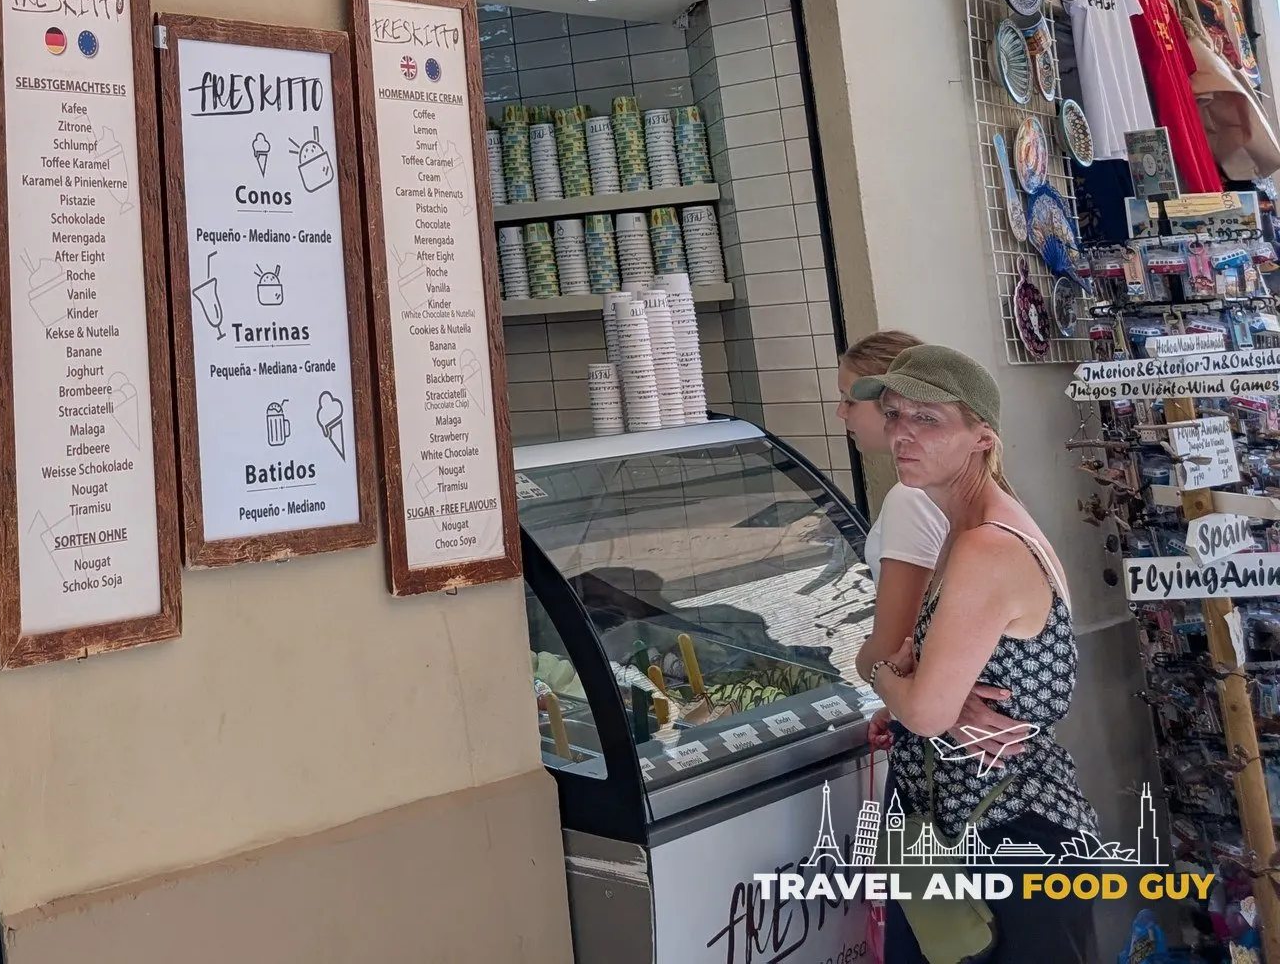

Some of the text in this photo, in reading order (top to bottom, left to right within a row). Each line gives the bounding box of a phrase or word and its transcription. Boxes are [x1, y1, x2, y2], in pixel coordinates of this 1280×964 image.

[372, 18, 459, 50] FRESKITTO
[15, 77, 126, 95] SELBSTGEMACHTES EIS
[188, 71, 323, 116] FRESKITTO
[379, 88, 463, 104] HOMEMADE ICE CREAM
[61, 103, 87, 114] Kafee
[413, 109, 435, 119] Coffee
[58, 121, 92, 133] Zitrone
[413, 126, 437, 135] Lemon
[53, 139, 98, 151] Schlumpf
[416, 141, 438, 150] Smurf
[41, 157, 110, 169] Toffee Karamel
[401, 155, 453, 167] Toffee Caramel
[22, 175, 127, 189] Karamel & Pinienkerne
[418, 172, 441, 181] Cream
[235, 185, 292, 205] Conos
[395, 187, 463, 198] Caramel & Pinenuts
[60, 195, 95, 206] Pistazie
[416, 204, 448, 213] Pistachio
[51, 213, 105, 224] Schokolade
[415, 219, 451, 229] Chocolate
[52, 232, 105, 245] Merengada
[196, 228, 332, 245] Pequeño Mediano Grande
[414, 236, 454, 248] Merengada
[55, 251, 105, 264] After Eight
[417, 251, 454, 263] After Eight
[66, 270, 95, 281] Roche
[426, 267, 448, 276] Roche
[67, 289, 96, 299] Vanile
[426, 284, 450, 293] Vanilla
[428, 299, 451, 308] Kinder
[67, 308, 98, 319] Kinder
[422, 309, 450, 319] Chocolate
[46, 326, 119, 339] Kekse & Nutella
[232, 322, 309, 342] Tarrinas
[410, 324, 471, 335] Cookies & Nutella
[429, 341, 456, 351] Banana
[66, 347, 102, 358] Banane
[432, 357, 456, 368] Yogurt
[66, 366, 104, 379] Joghurt
[210, 359, 336, 380] Pequeña Mediana Grande
[426, 373, 464, 384] Blackberry
[59, 384, 112, 398] Brombeere
[1121, 383, 1138, 396] De
[1231, 379, 1279, 394] Games
[435, 416, 462, 427] Malaga
[70, 424, 105, 438] Malaga
[429, 432, 469, 443] Strawberry
[66, 444, 110, 456] Erdbeere
[421, 446, 479, 460] White Chocolate
[42, 459, 134, 479] Weisse Schokolade
[245, 460, 316, 484] Batidos
[438, 465, 465, 477] Nougat
[71, 482, 108, 497] Nougat
[437, 481, 468, 492] Tiramisu
[70, 503, 112, 516] Tiramisu
[239, 500, 326, 522] Pequeño Mediano
[407, 498, 497, 519] SUGAR FREE FLAVOURS
[441, 520, 469, 532] Nougat
[54, 528, 128, 549] SORTEN OHNE
[1198, 515, 1252, 556] Spain
[435, 535, 477, 549] Choco Soya
[74, 556, 111, 572] Nougat
[62, 574, 122, 593] Schoko Soja
